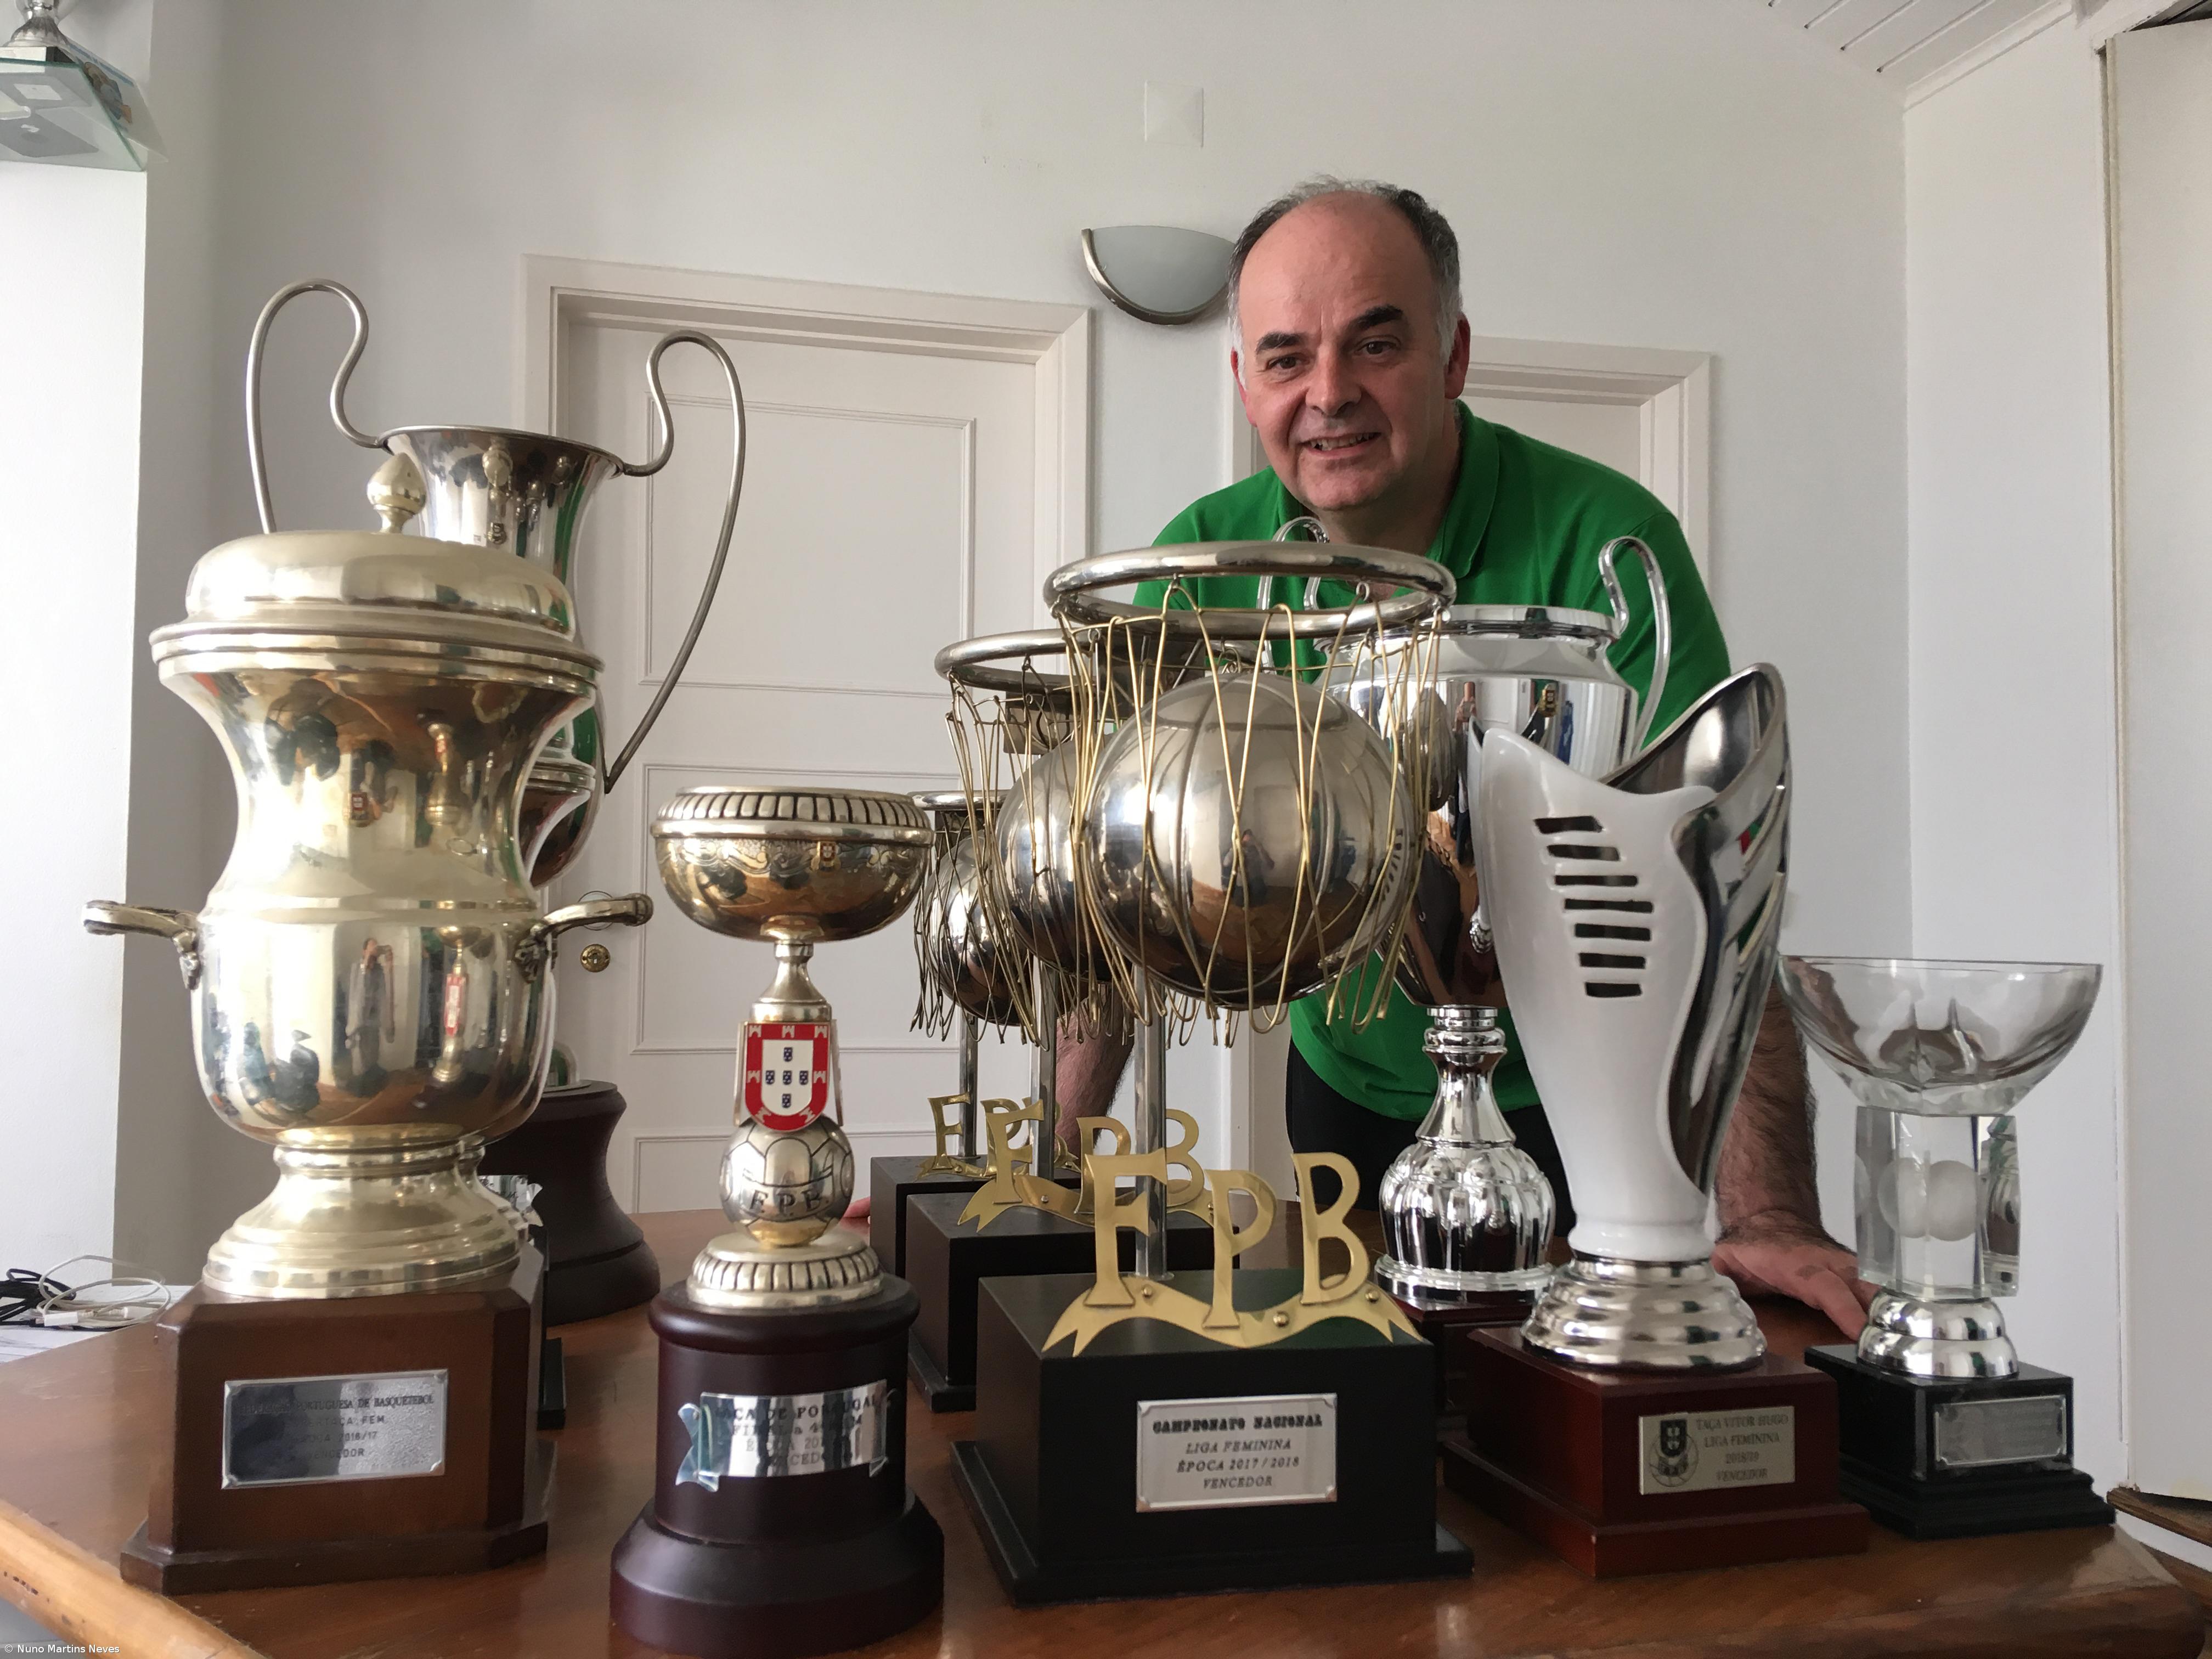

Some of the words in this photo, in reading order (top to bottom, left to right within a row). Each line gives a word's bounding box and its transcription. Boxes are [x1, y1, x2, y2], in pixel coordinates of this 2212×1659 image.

[1083, 1147, 1370, 1330] FPB
[297, 1399, 353, 1412] PORTUGUESA
[358, 1397, 370, 1408] DE
[374, 1394, 434, 1409] BASQUETEBOL
[362, 1415, 385, 1424] FEM
[1152, 1418, 1246, 1434] CAMPEONATO
[1253, 1414, 1323, 1429] NACIONAL
[1696, 1418, 1722, 1431] TAÇA
[1724, 1415, 1756, 1428] VITOR
[1758, 1413, 1789, 1426] HUGO
[1186, 1442, 1218, 1454] LIGA
[1223, 1438, 1291, 1453] FEMININA
[1704, 1436, 1728, 1448] LIGA
[1731, 1433, 1781, 1446] FEMININA
[1177, 1458, 1224, 1473] ÉPOCA
[1203, 1475, 1273, 1489] VENCEDOR
[1717, 1468, 1768, 1482] VENCEDOR
